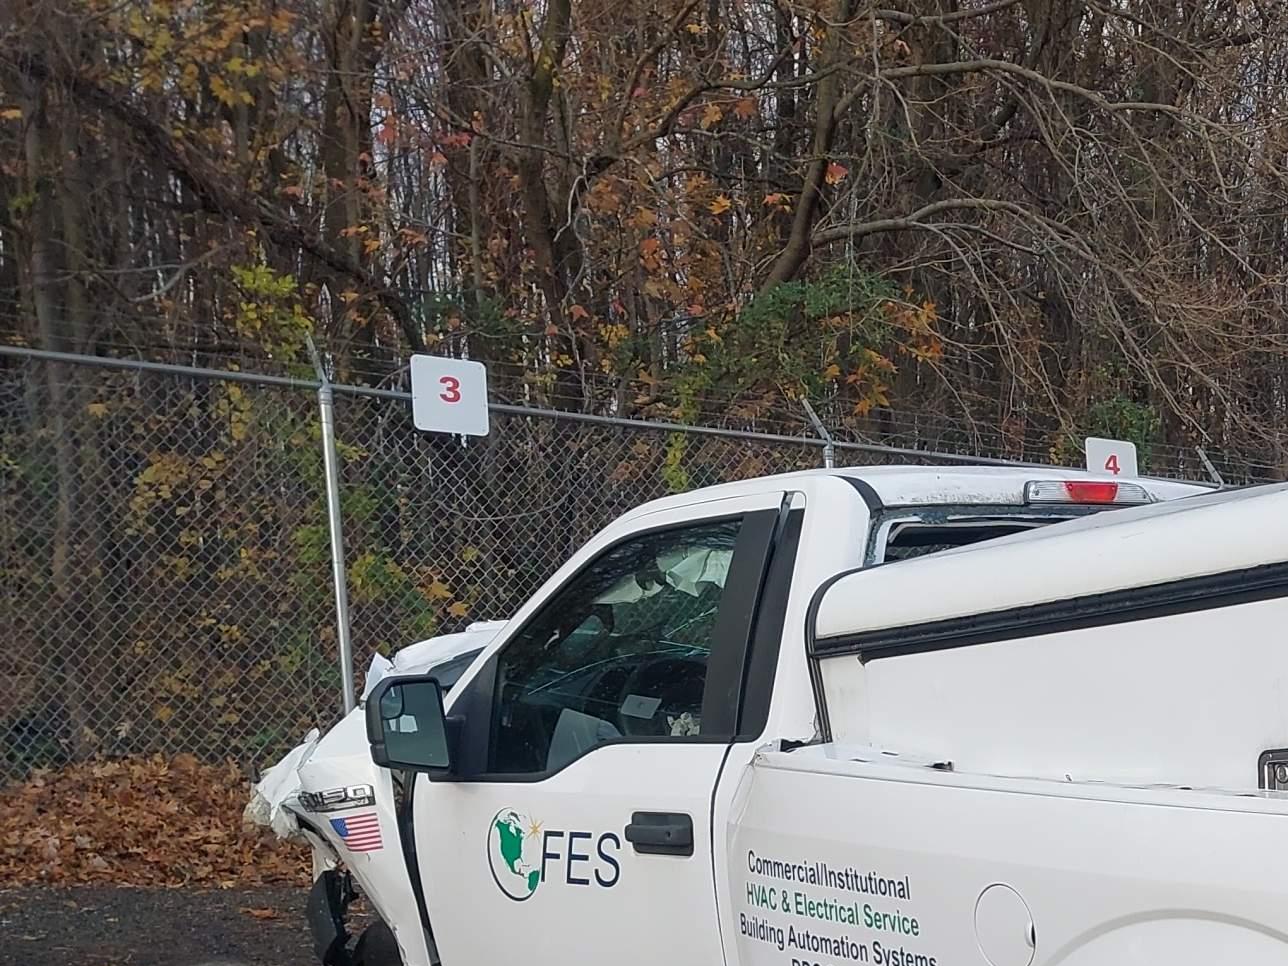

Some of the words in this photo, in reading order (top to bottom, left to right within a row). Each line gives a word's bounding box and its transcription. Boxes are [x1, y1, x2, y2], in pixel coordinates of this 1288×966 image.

[440, 376, 461, 403] 3
[1105, 455, 1120, 475] 4
[541, 830, 621, 888] FES
[748, 850, 911, 900] Commercial/Institutional
[746, 882, 777, 911] HVAC
[781, 890, 791, 913] &
[794, 892, 860, 925] Electrical
[863, 903, 920, 936] Service
[740, 913, 784, 950] Building
[788, 925, 869, 964] Automation
